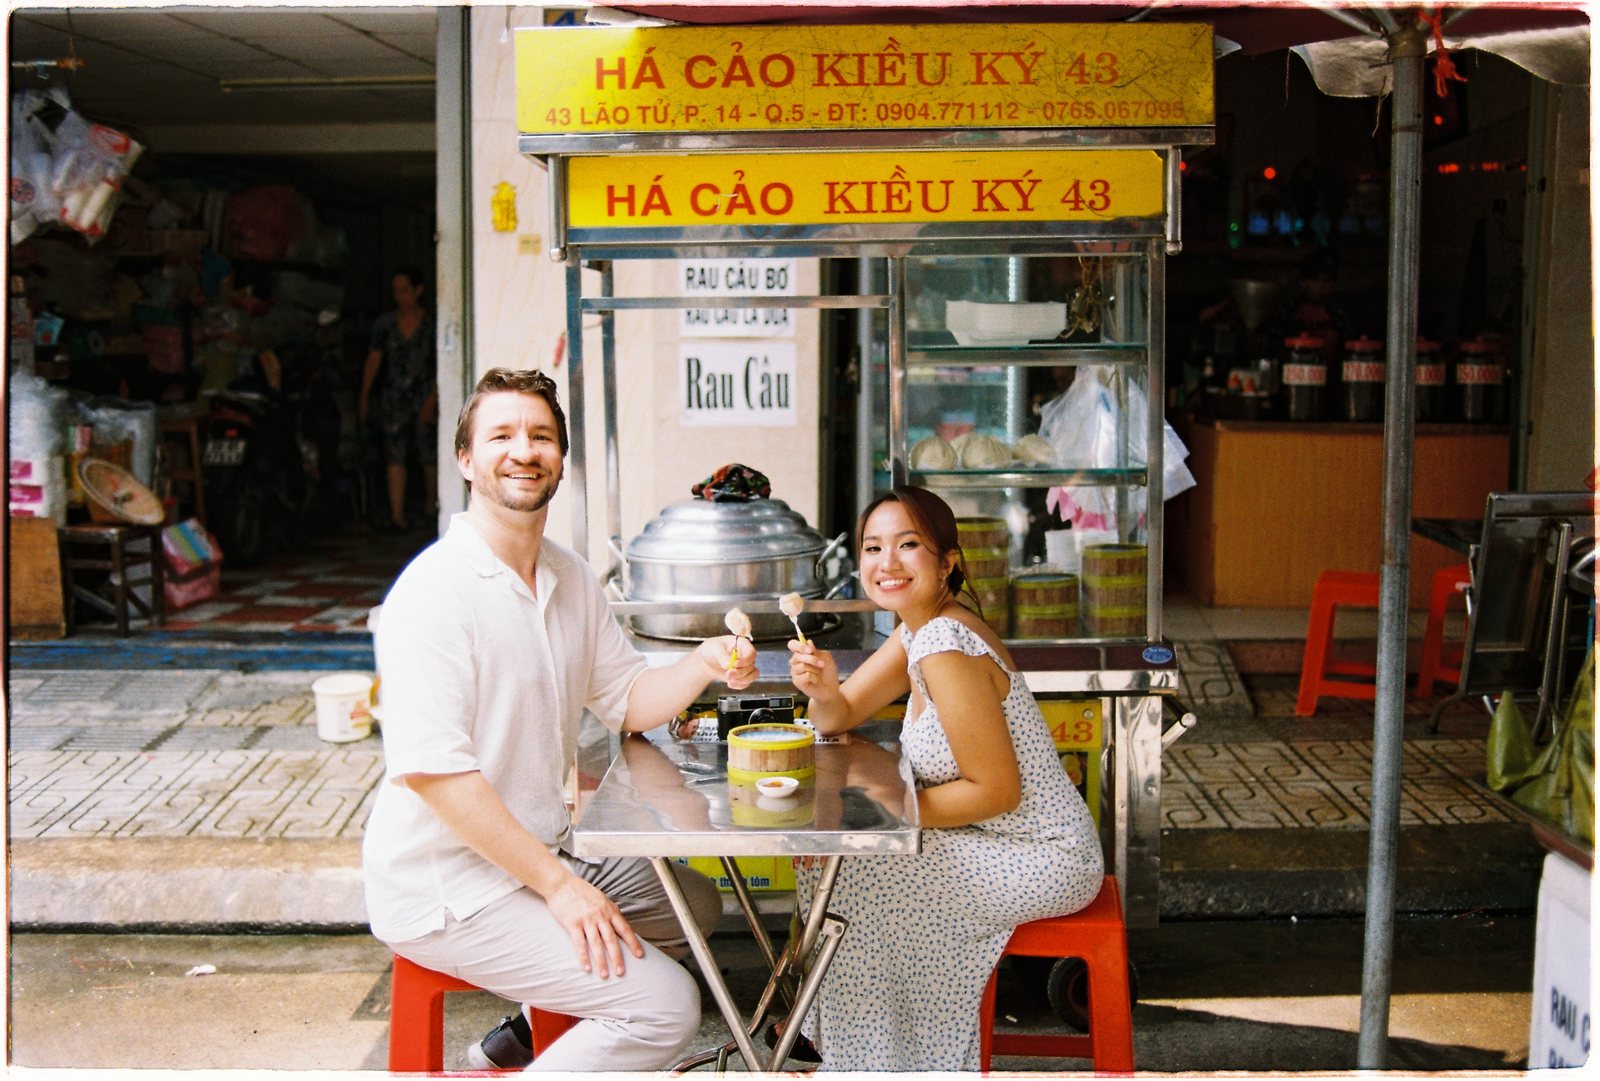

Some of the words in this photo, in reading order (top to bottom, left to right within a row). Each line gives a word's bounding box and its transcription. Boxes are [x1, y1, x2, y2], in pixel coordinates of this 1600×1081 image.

[596, 47, 666, 90] HÁ
[684, 41, 796, 89] CẢO
[811, 37, 952, 87] KIỀU
[970, 41, 1046, 86] KÝ
[1065, 52, 1119, 86] 43
[545, 107, 571, 126] 43
[580, 102, 630, 126] LÃO
[684, 104, 707, 124] P.
[716, 104, 742, 123] 14
[765, 103, 804, 124] Q.5
[828, 103, 868, 122] ĐT:
[876, 102, 1019, 122] 0904.771112
[606, 175, 672, 217] HÁ
[690, 170, 794, 216] CẢO
[823, 165, 955, 214] KIỀU
[972, 169, 1042, 212] KÝ
[1060, 179, 1111, 212] 43
[686, 267, 719, 289] RAU
[686, 356, 734, 410] Rau
[744, 355, 790, 410] Câu
[1050, 720, 1093, 743] 43
[1550, 986, 1577, 1042] RAU
